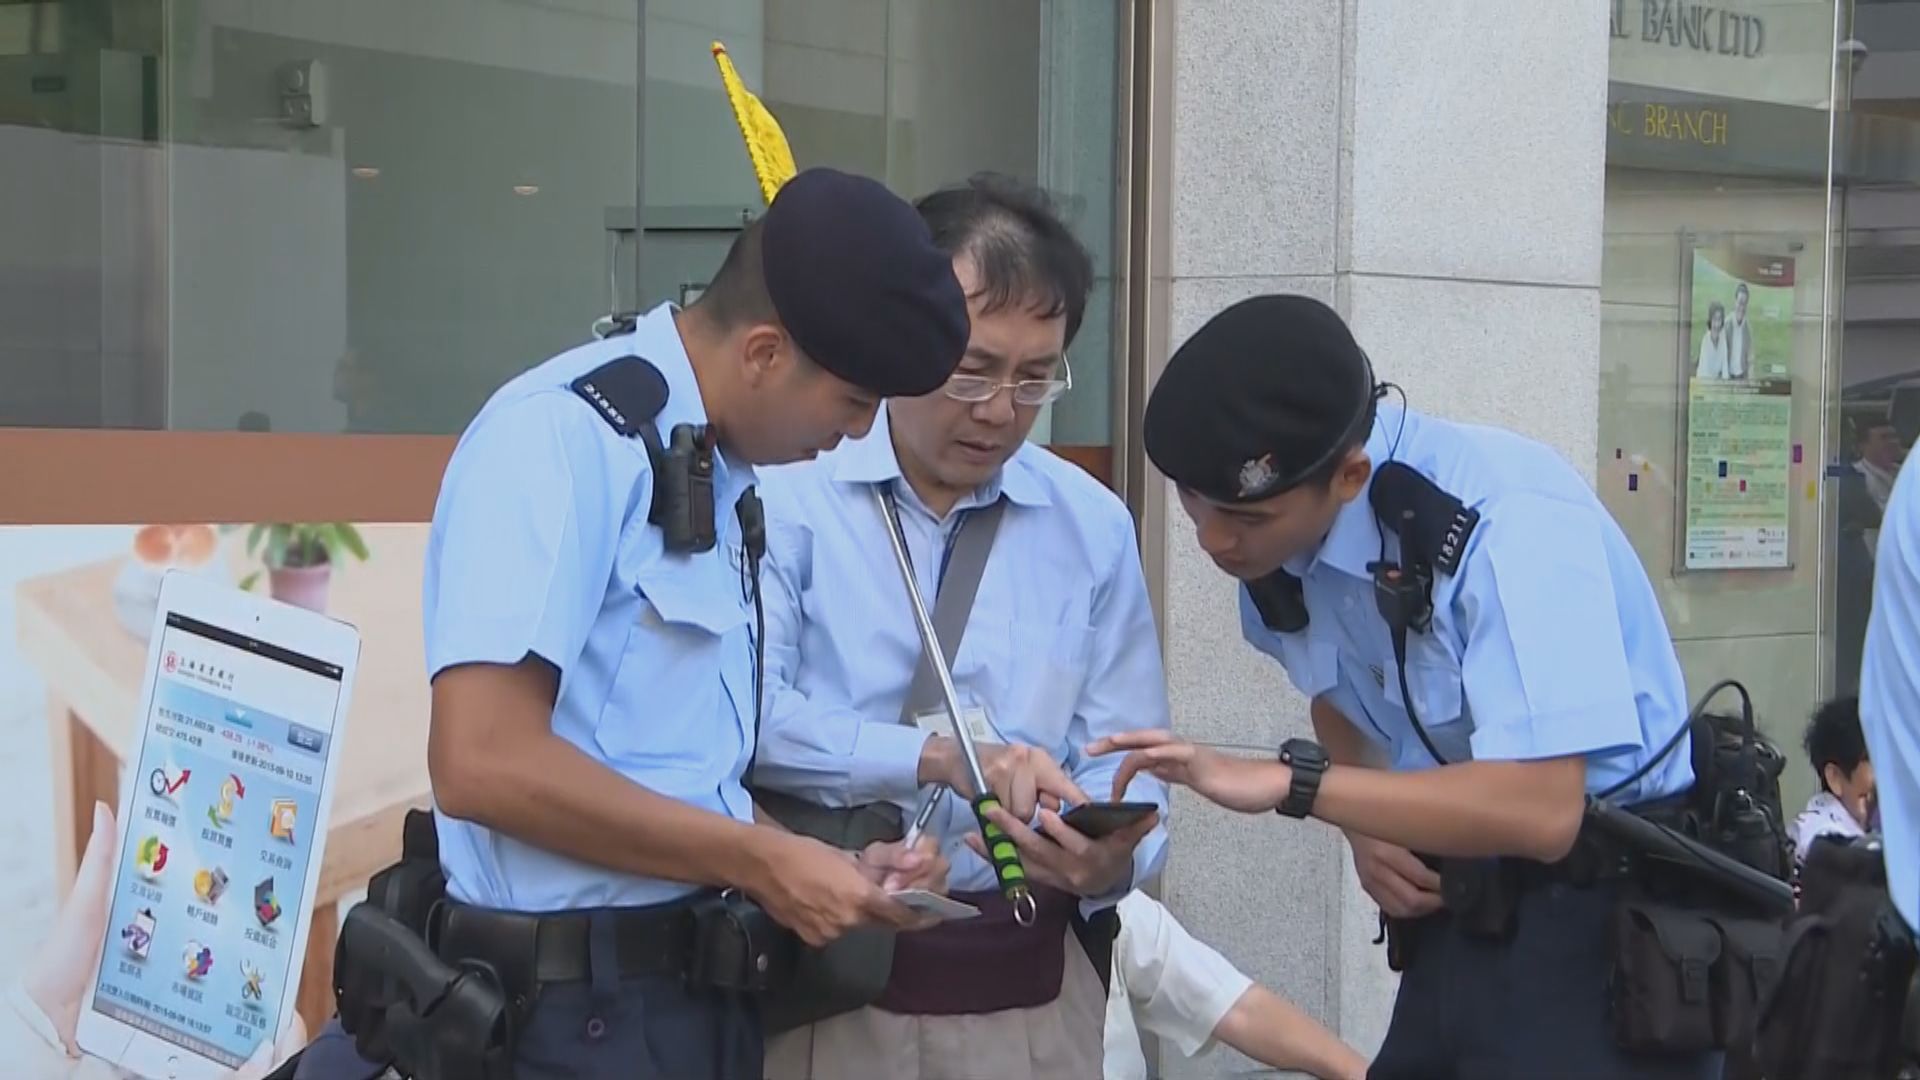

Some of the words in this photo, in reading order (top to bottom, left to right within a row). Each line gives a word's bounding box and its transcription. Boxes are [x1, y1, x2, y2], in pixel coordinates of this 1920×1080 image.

[1641, 0, 1713, 51] BANK
[1643, 103, 1729, 145] BRANCH
[1437, 513, 1470, 566] 18211
